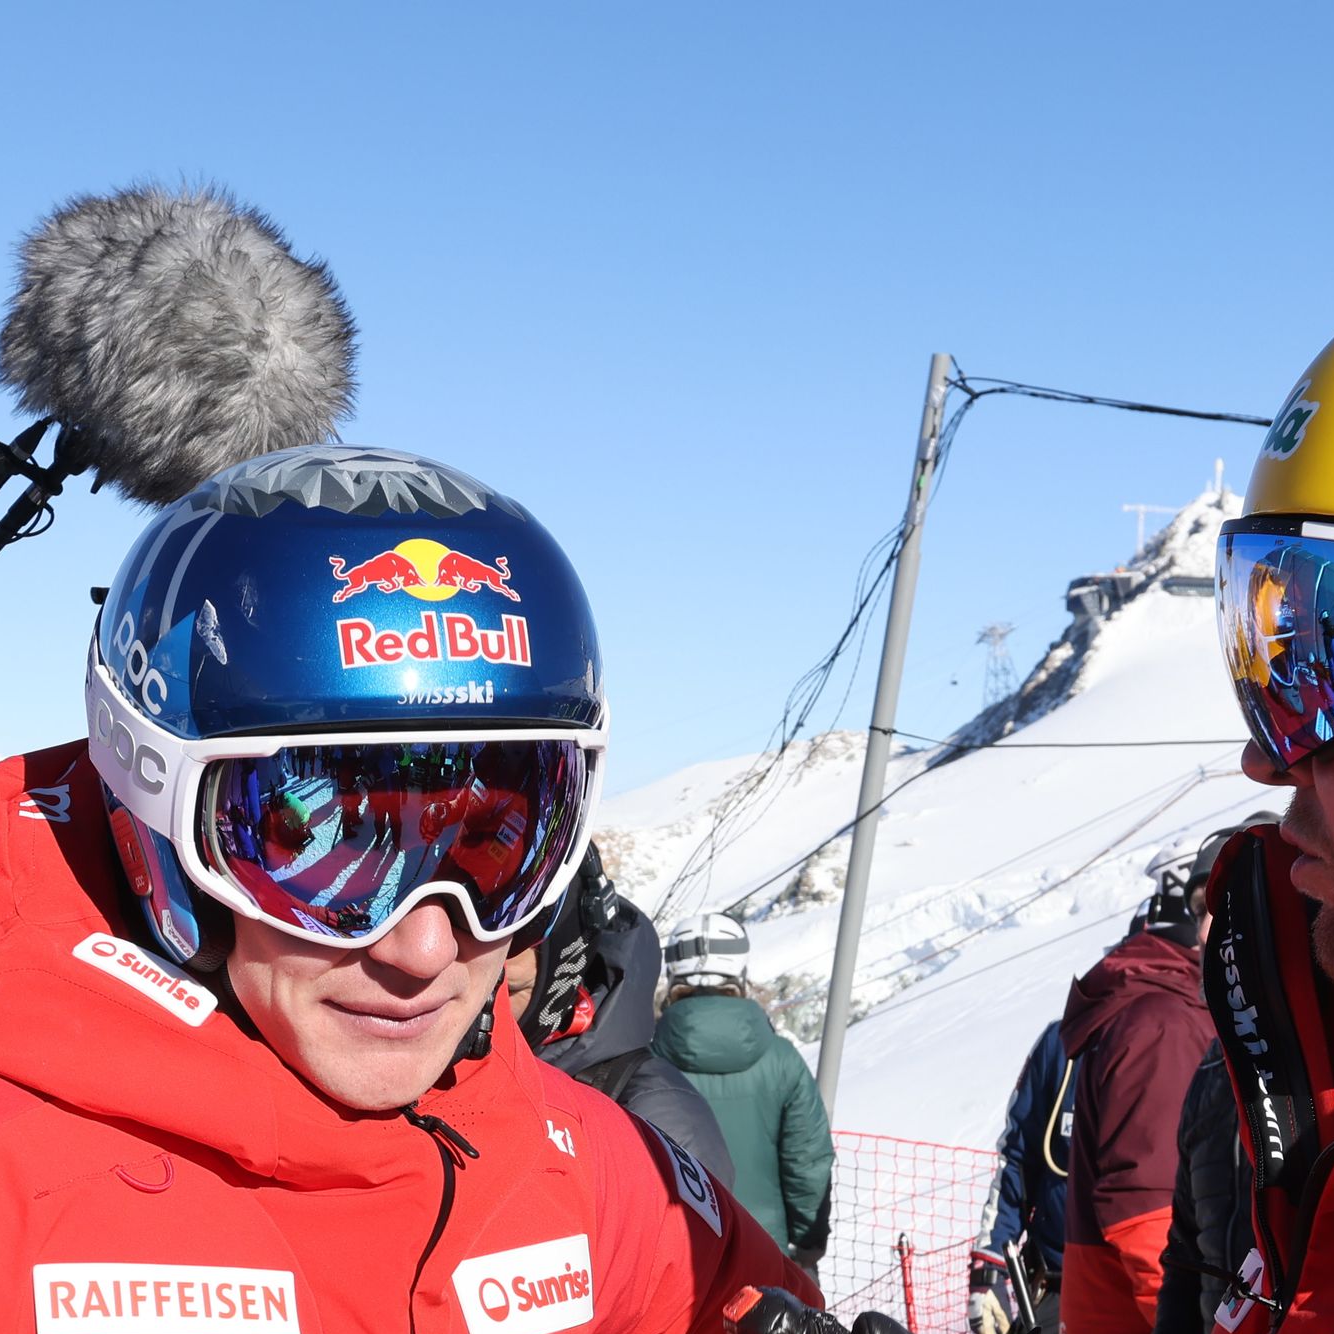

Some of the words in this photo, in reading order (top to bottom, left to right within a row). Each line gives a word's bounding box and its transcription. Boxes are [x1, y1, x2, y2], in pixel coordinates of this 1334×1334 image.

[337, 612, 442, 669] Red
[443, 613, 531, 667] Bull
[397, 680, 494, 705] swissski
[117, 952, 201, 1011] Sunrise
[49, 1280, 289, 1322] RAIFFEISEN
[511, 1262, 590, 1312] Sunrise
